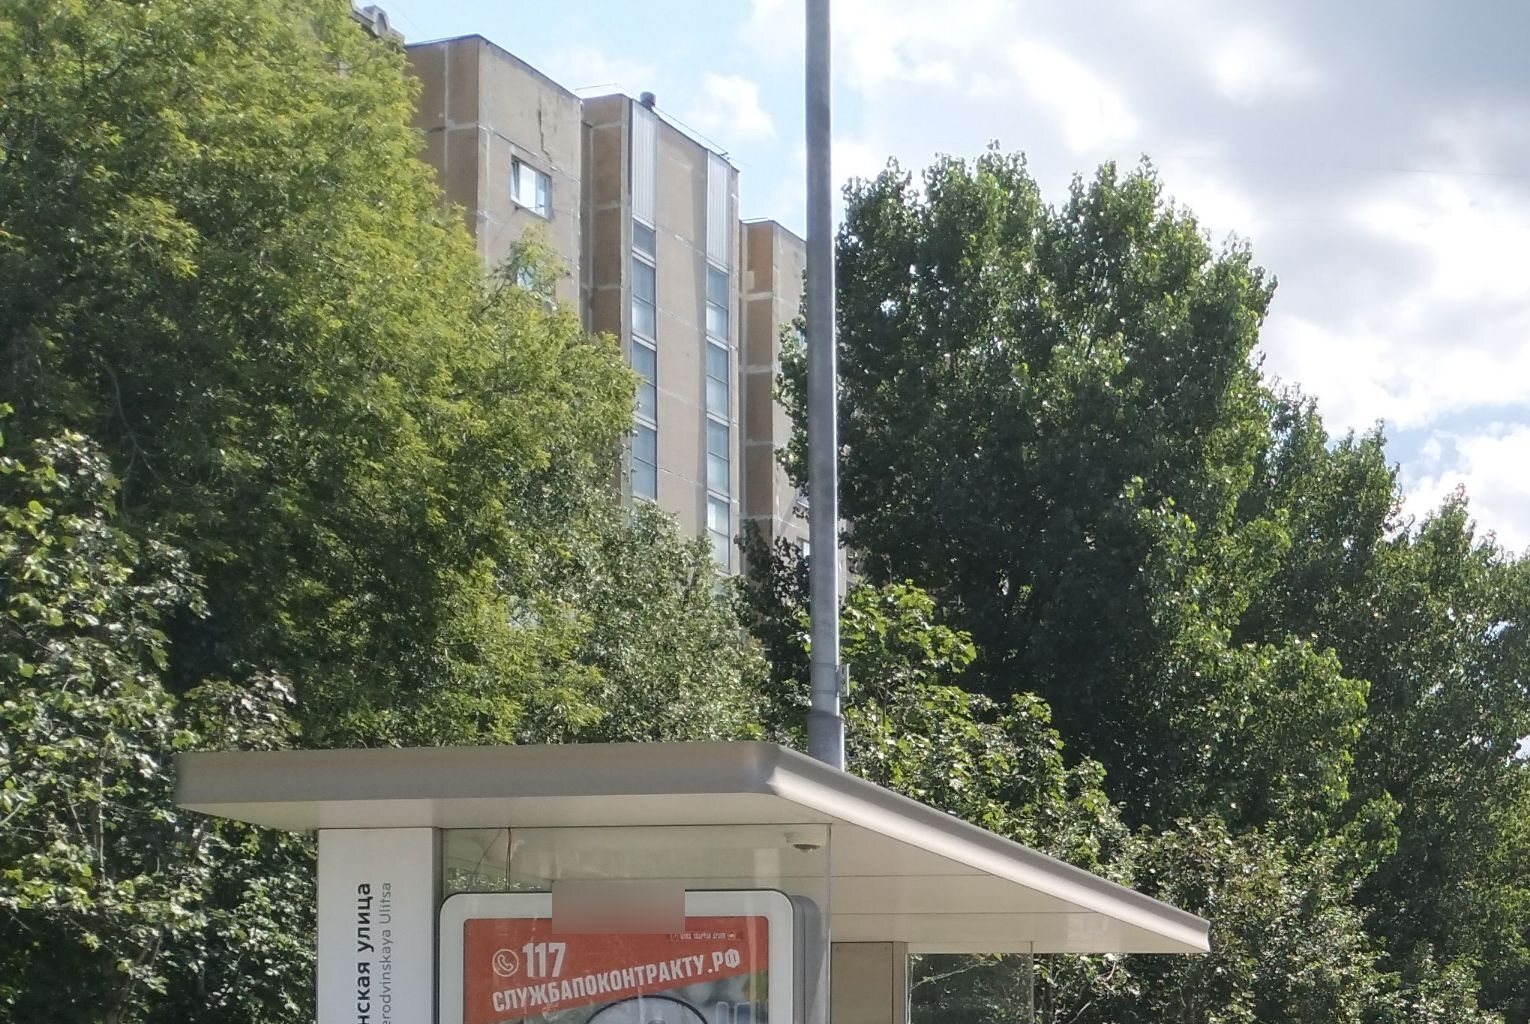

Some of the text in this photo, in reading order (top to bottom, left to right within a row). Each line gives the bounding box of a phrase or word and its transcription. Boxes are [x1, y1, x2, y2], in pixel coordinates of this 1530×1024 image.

[354, 883, 374, 953] улица
[378, 882, 392, 924] Ulitsa
[492, 948, 741, 1012] СЛУЖБАПОКОНТРАКТУ.РФ
[522, 942, 566, 978] 117
